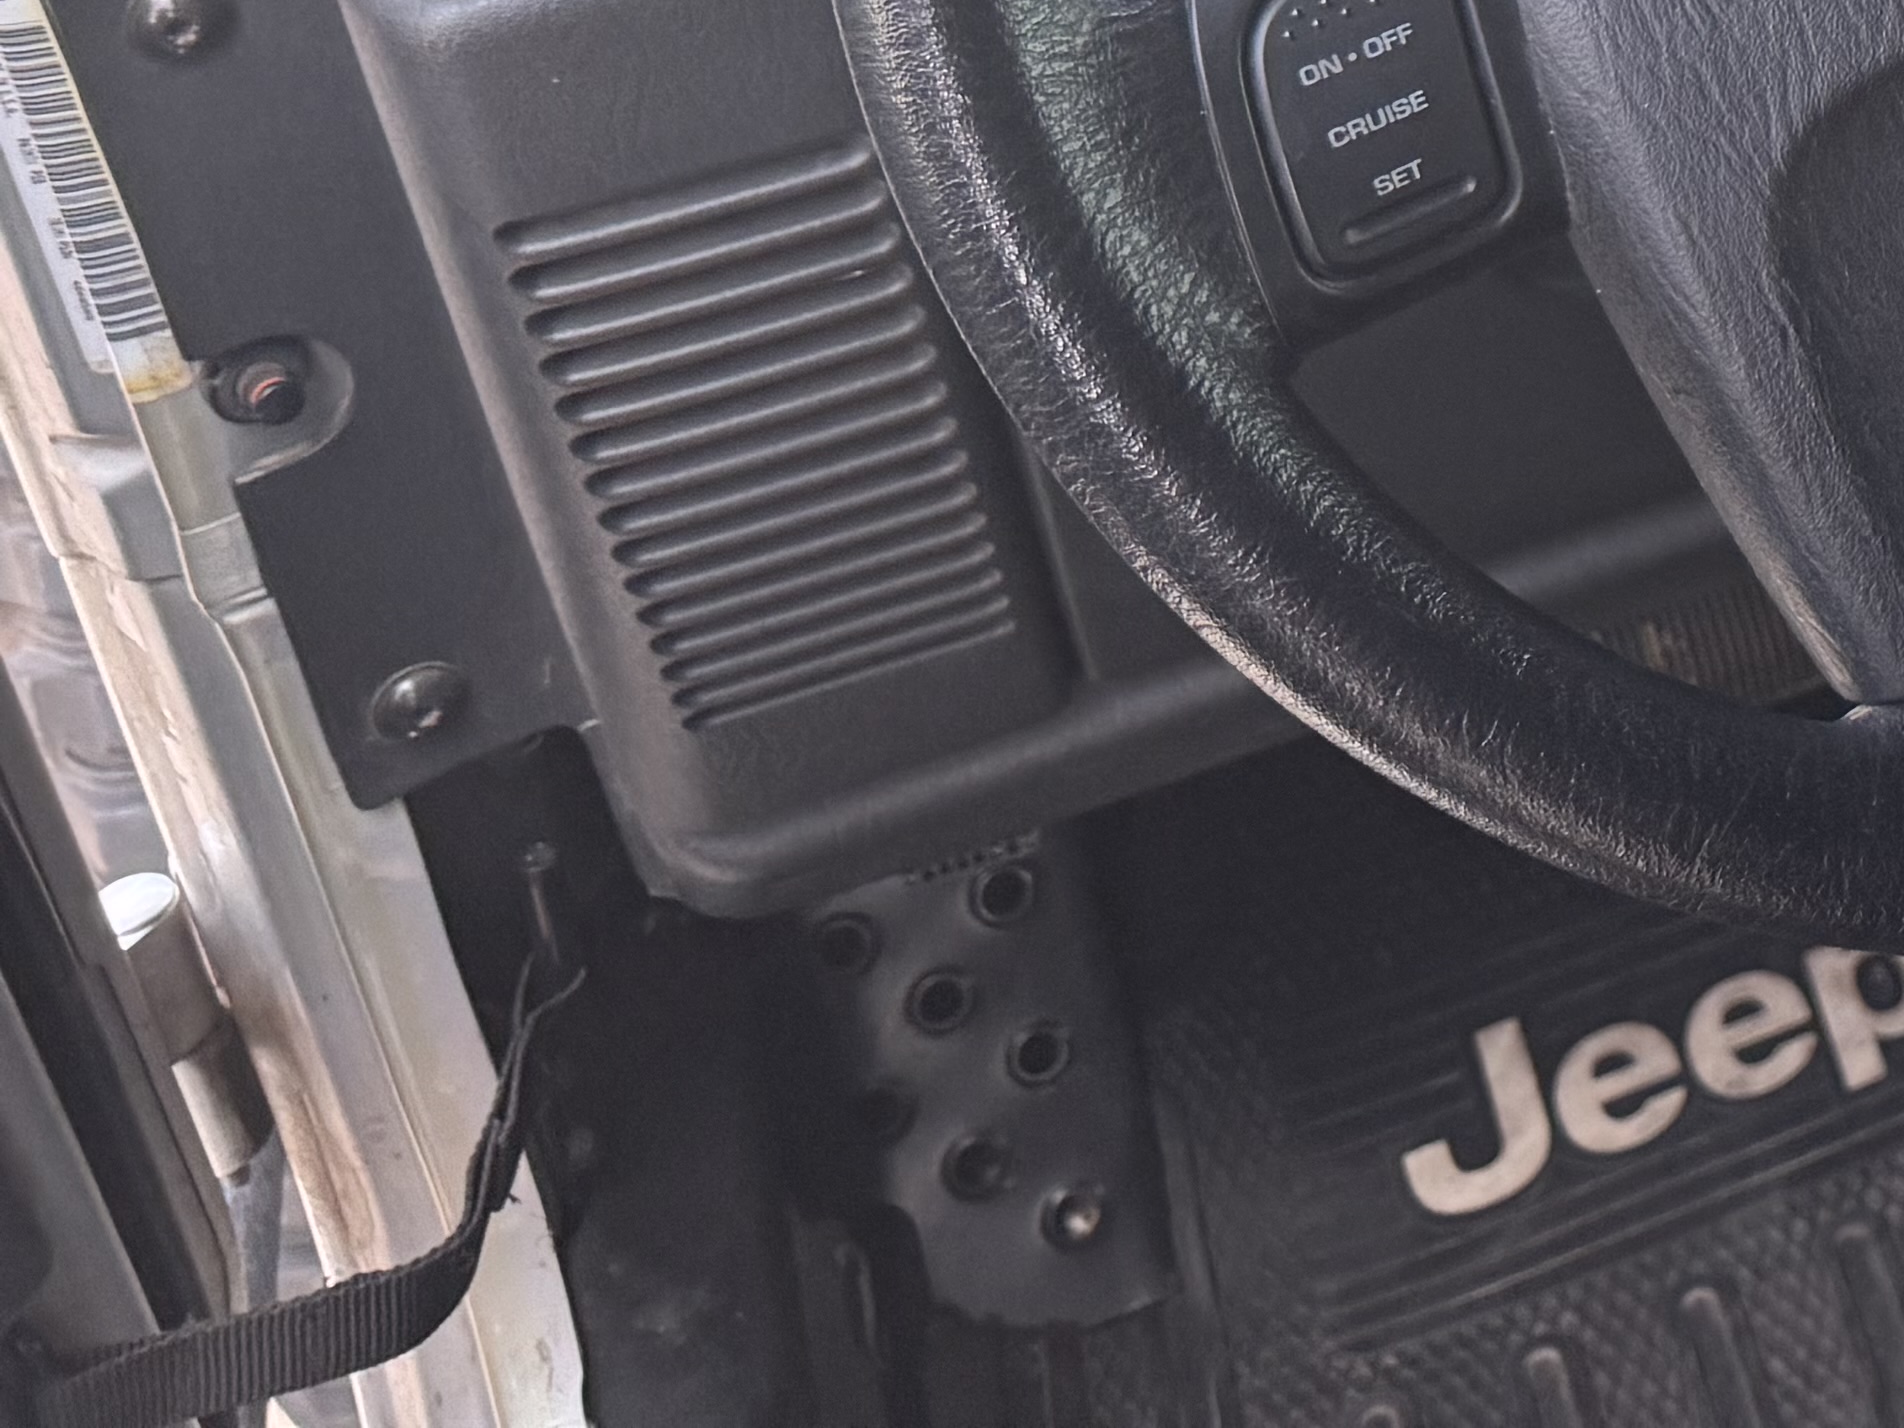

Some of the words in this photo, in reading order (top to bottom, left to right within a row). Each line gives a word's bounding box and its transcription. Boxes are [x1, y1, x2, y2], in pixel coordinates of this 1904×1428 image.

[1298, 53, 1344, 87] ON
[1362, 22, 1414, 59] OFF
[1327, 90, 1430, 149] CRUISE
[1372, 158, 1424, 197] SET
